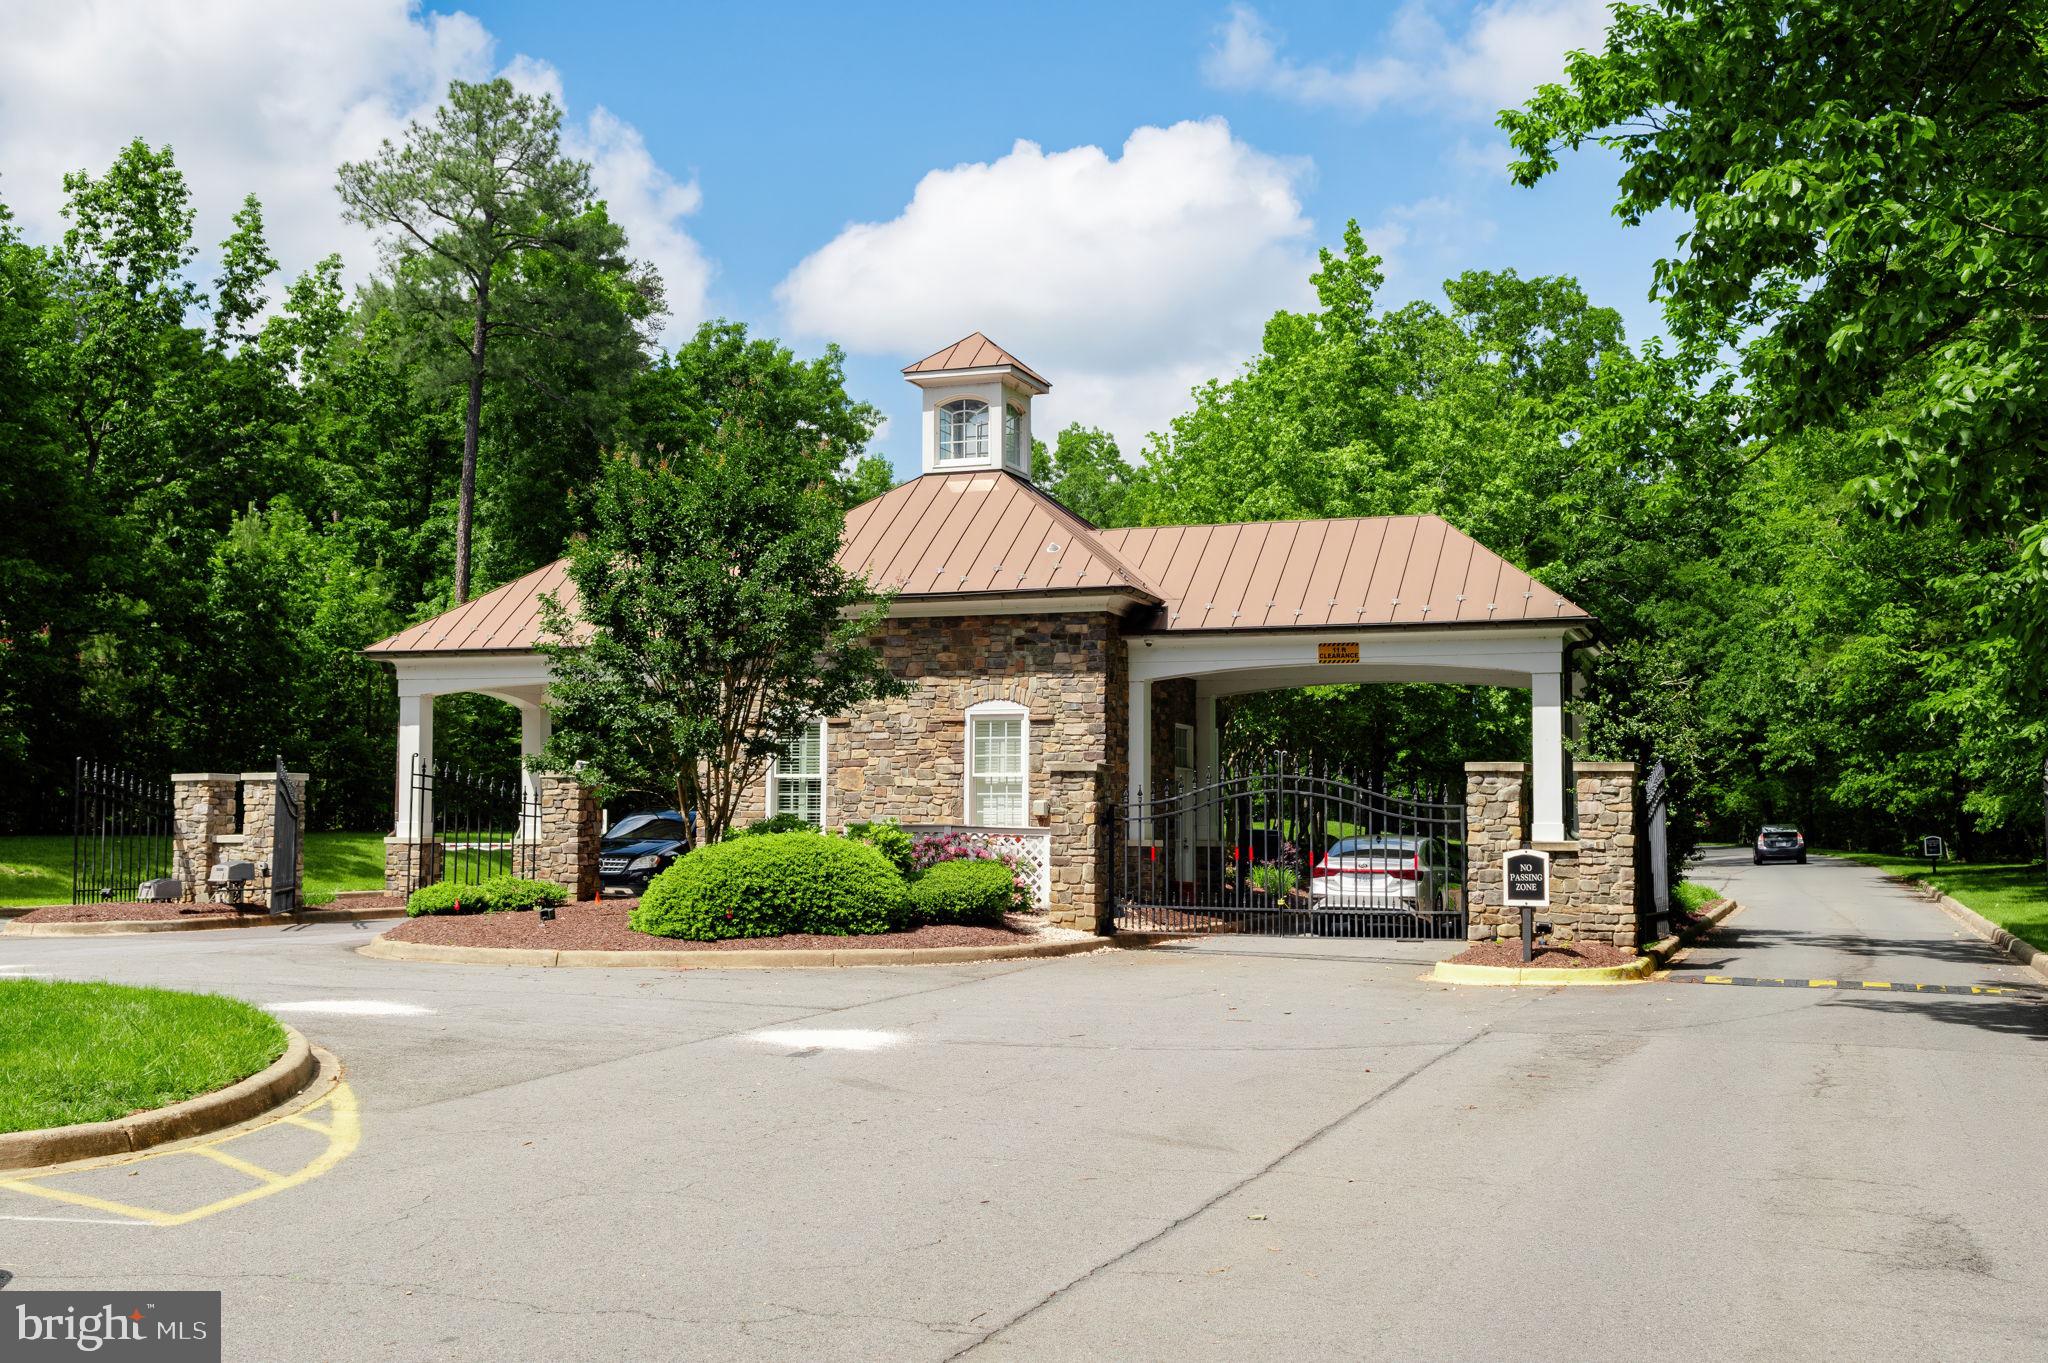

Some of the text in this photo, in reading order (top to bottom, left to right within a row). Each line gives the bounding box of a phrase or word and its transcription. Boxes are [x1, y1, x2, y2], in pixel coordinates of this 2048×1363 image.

[1520, 863, 1532, 872] NO
[1510, 873, 1543, 882] PASSING
[1515, 883, 1537, 891] ZONE
